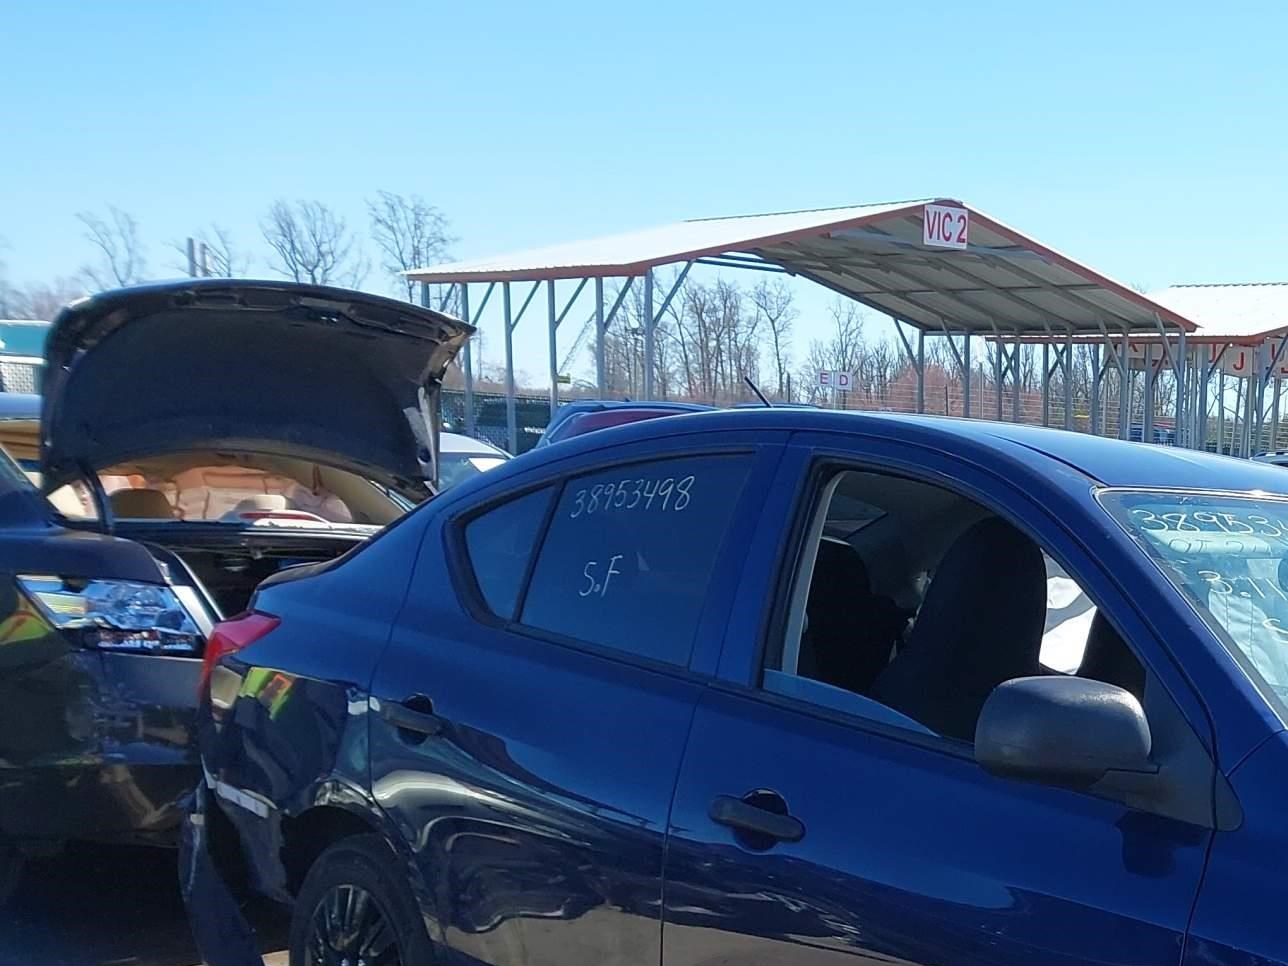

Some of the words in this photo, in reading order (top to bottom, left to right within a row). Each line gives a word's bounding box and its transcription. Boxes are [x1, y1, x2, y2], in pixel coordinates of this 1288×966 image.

[926, 210, 953, 242] VIC
[956, 214, 967, 243] 2
[1232, 351, 1245, 371] J
[570, 475, 696, 518] 38953498
[578, 554, 625, 597] S.F
[1198, 570, 1288, 601] 3.11
